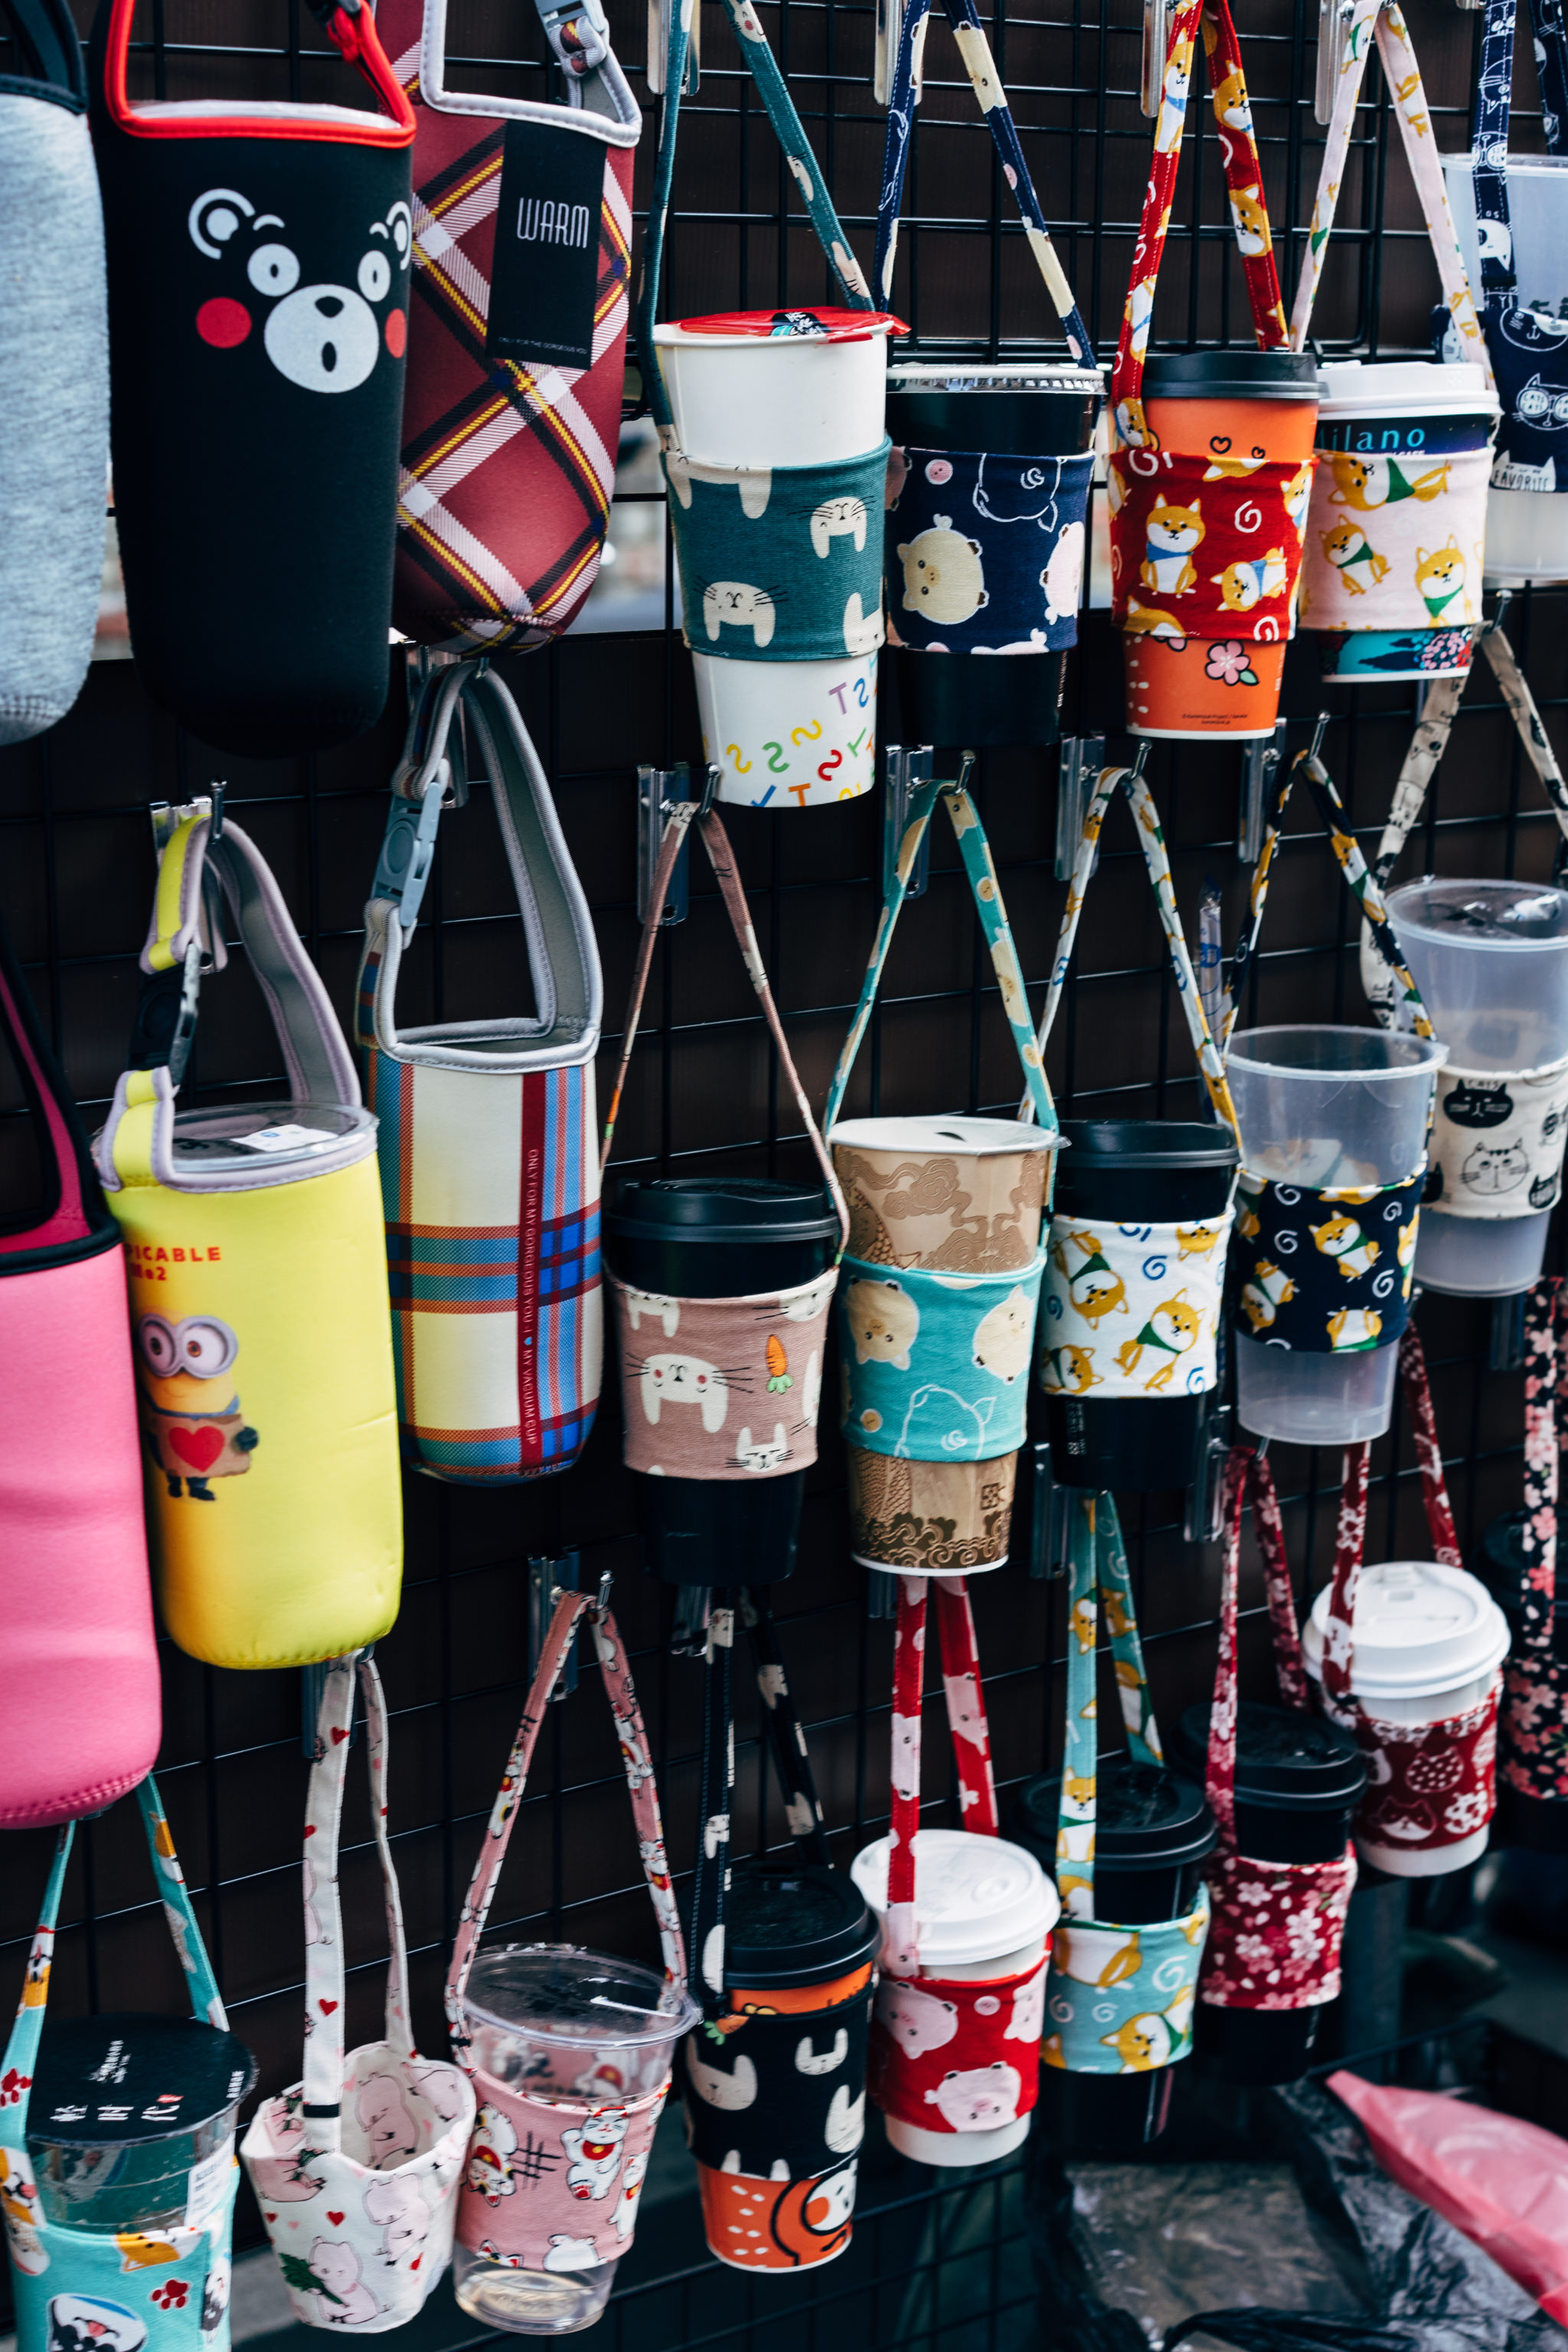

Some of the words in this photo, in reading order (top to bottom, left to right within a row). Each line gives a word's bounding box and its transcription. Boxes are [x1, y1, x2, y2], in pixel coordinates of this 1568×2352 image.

[516, 197, 590, 249] WARM
[526, 1148, 540, 1179] ONLY
[526, 1182, 538, 1207] FOR
[524, 1209, 537, 1225] MY
[523, 1228, 536, 1295] GORGEOUS
[522, 1297, 534, 1323] YOU
[522, 1349, 534, 1367] MY
